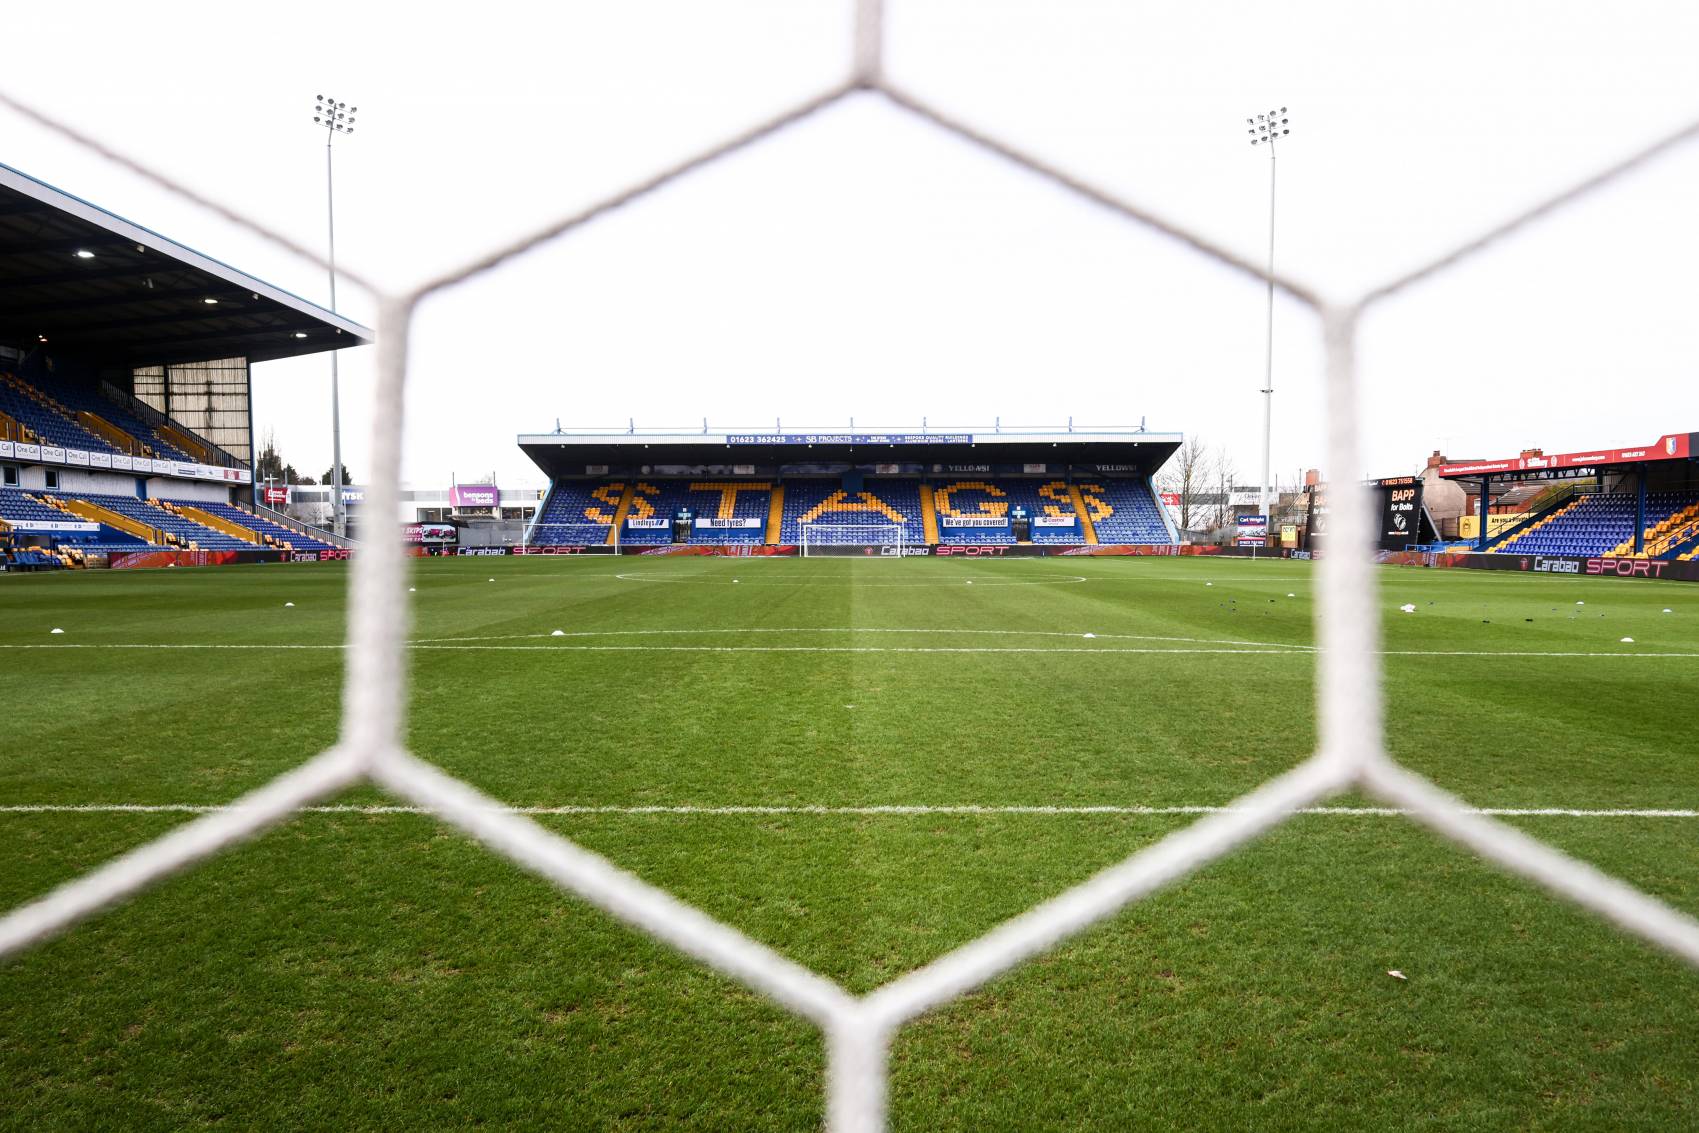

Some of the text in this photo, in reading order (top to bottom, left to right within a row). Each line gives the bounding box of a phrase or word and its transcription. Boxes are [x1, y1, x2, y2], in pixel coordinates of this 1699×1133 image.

[806, 435, 852, 443] SB PROJECTS
[1391, 489, 1415, 502] BAPP
[1399, 502, 1413, 511] Bolts
[710, 519, 747, 529] Need tyres?
[945, 518, 962, 526] We've
[983, 518, 1007, 526] covered!
[290, 550, 317, 562] Carabao
[457, 546, 587, 556] Carabao SPORT
[881, 546, 1010, 556] Carabao SPORT
[1533, 556, 1669, 578] Carabao SPORT
